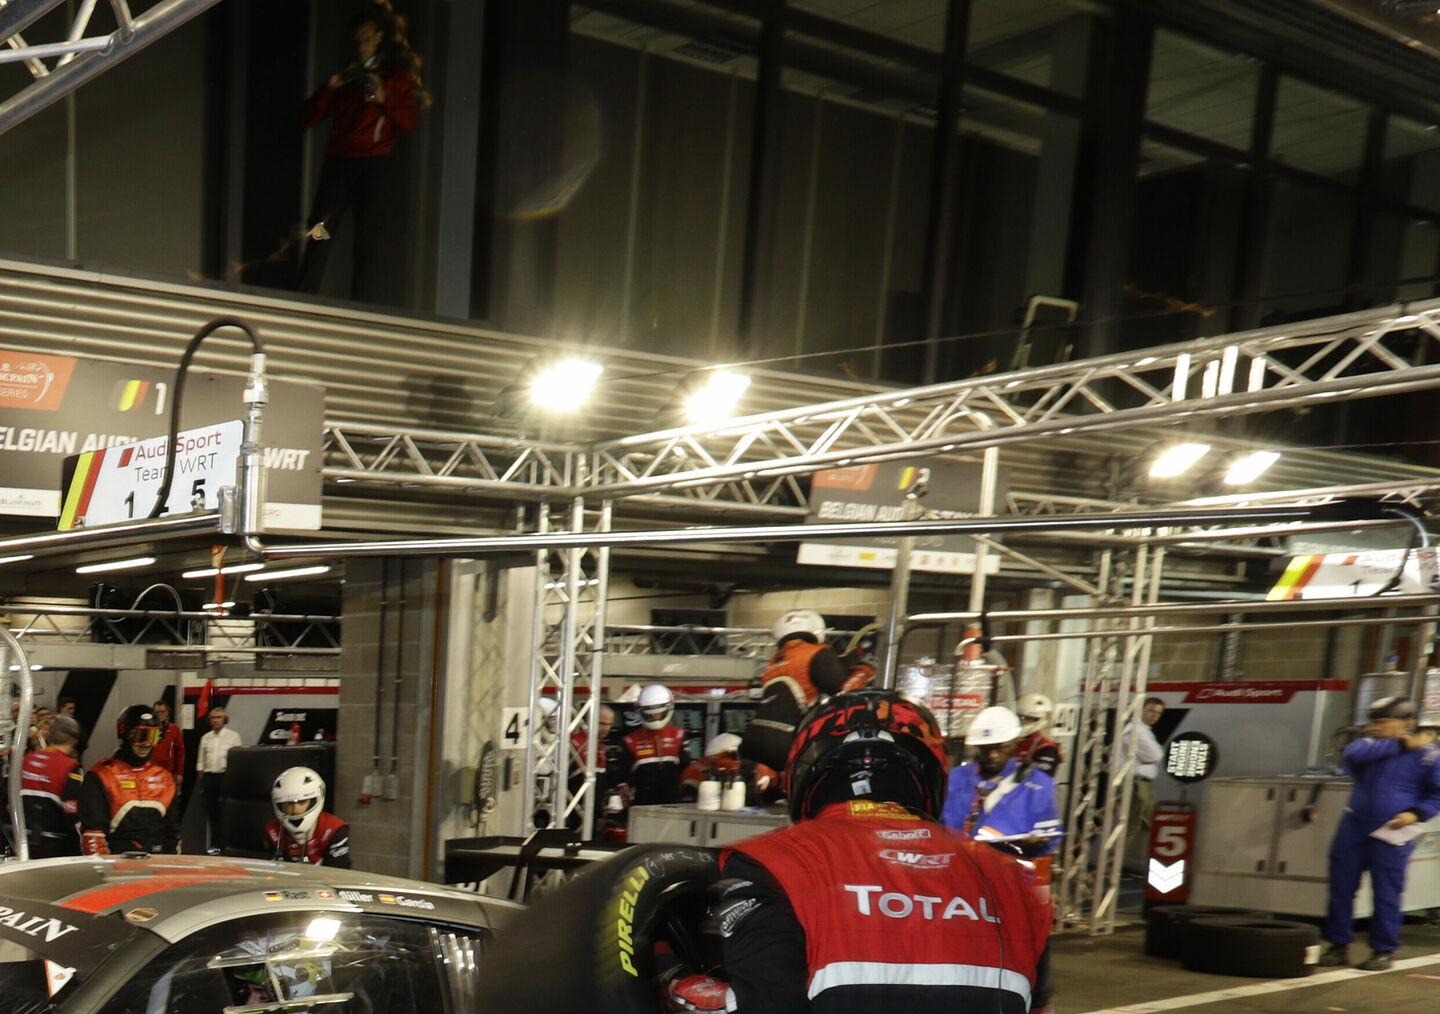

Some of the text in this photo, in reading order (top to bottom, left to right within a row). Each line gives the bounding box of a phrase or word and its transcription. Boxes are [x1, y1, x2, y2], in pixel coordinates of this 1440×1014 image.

[155, 382, 168, 415] 1
[176, 432, 222, 455] Sport
[265, 447, 310, 470] WRT
[180, 453, 218, 474] WRT
[818, 501, 878, 521] BELGIAN
[1167, 741, 1180, 774] START
[1175, 740, 1190, 777] ENGINE
[1186, 740, 1201, 777] ENGINE
[1198, 743, 1210, 776] START
[854, 803, 876, 811] FIA
[1154, 826, 1188, 857] 5
[844, 884, 1001, 924] TOTAL
[617, 866, 651, 978] PIRELLI
